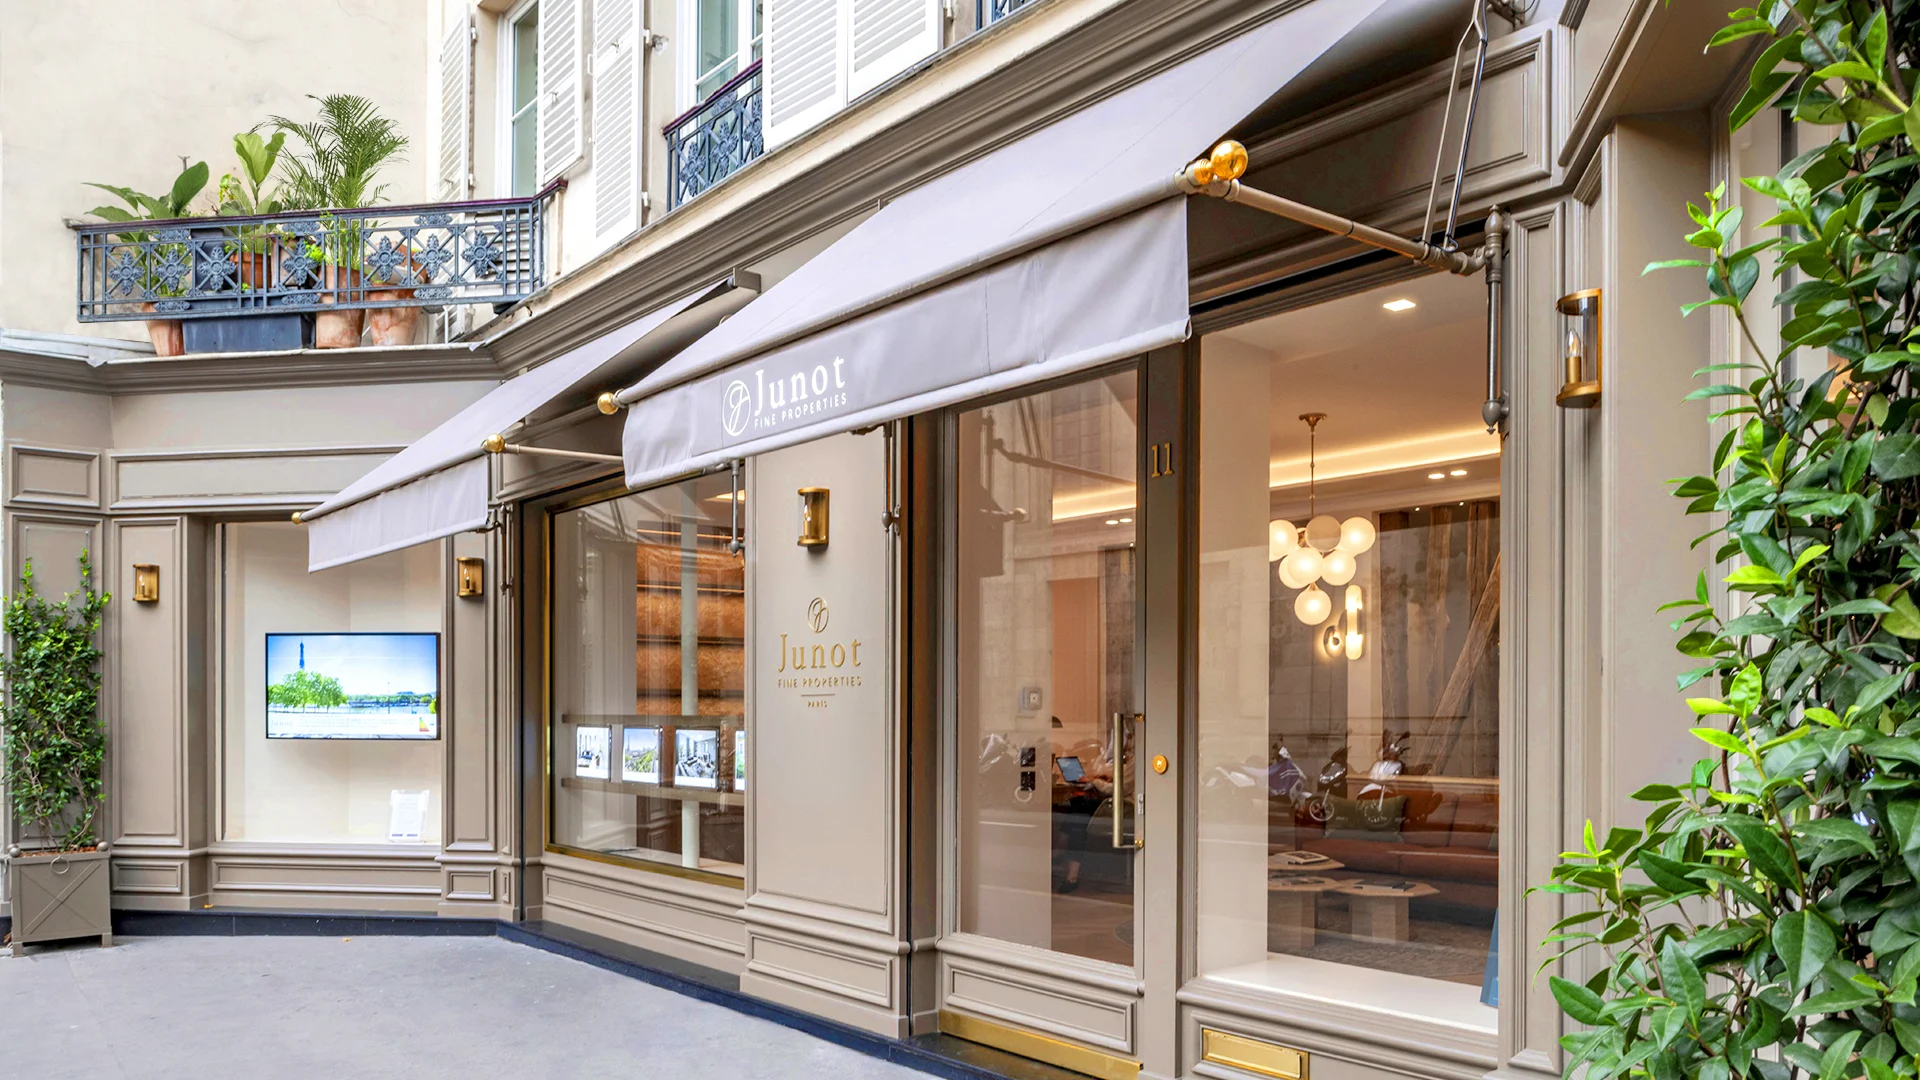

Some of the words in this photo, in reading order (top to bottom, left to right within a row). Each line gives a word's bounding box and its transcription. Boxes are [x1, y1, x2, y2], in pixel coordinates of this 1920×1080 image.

[754, 355, 846, 416] Junot
[754, 412, 776, 430] FINE
[782, 392, 847, 422] PROPERTIES
[1151, 442, 1174, 478] 11
[778, 633, 862, 673] Junot
[778, 678, 798, 688] FINE
[802, 676, 862, 688] PROPERTIES
